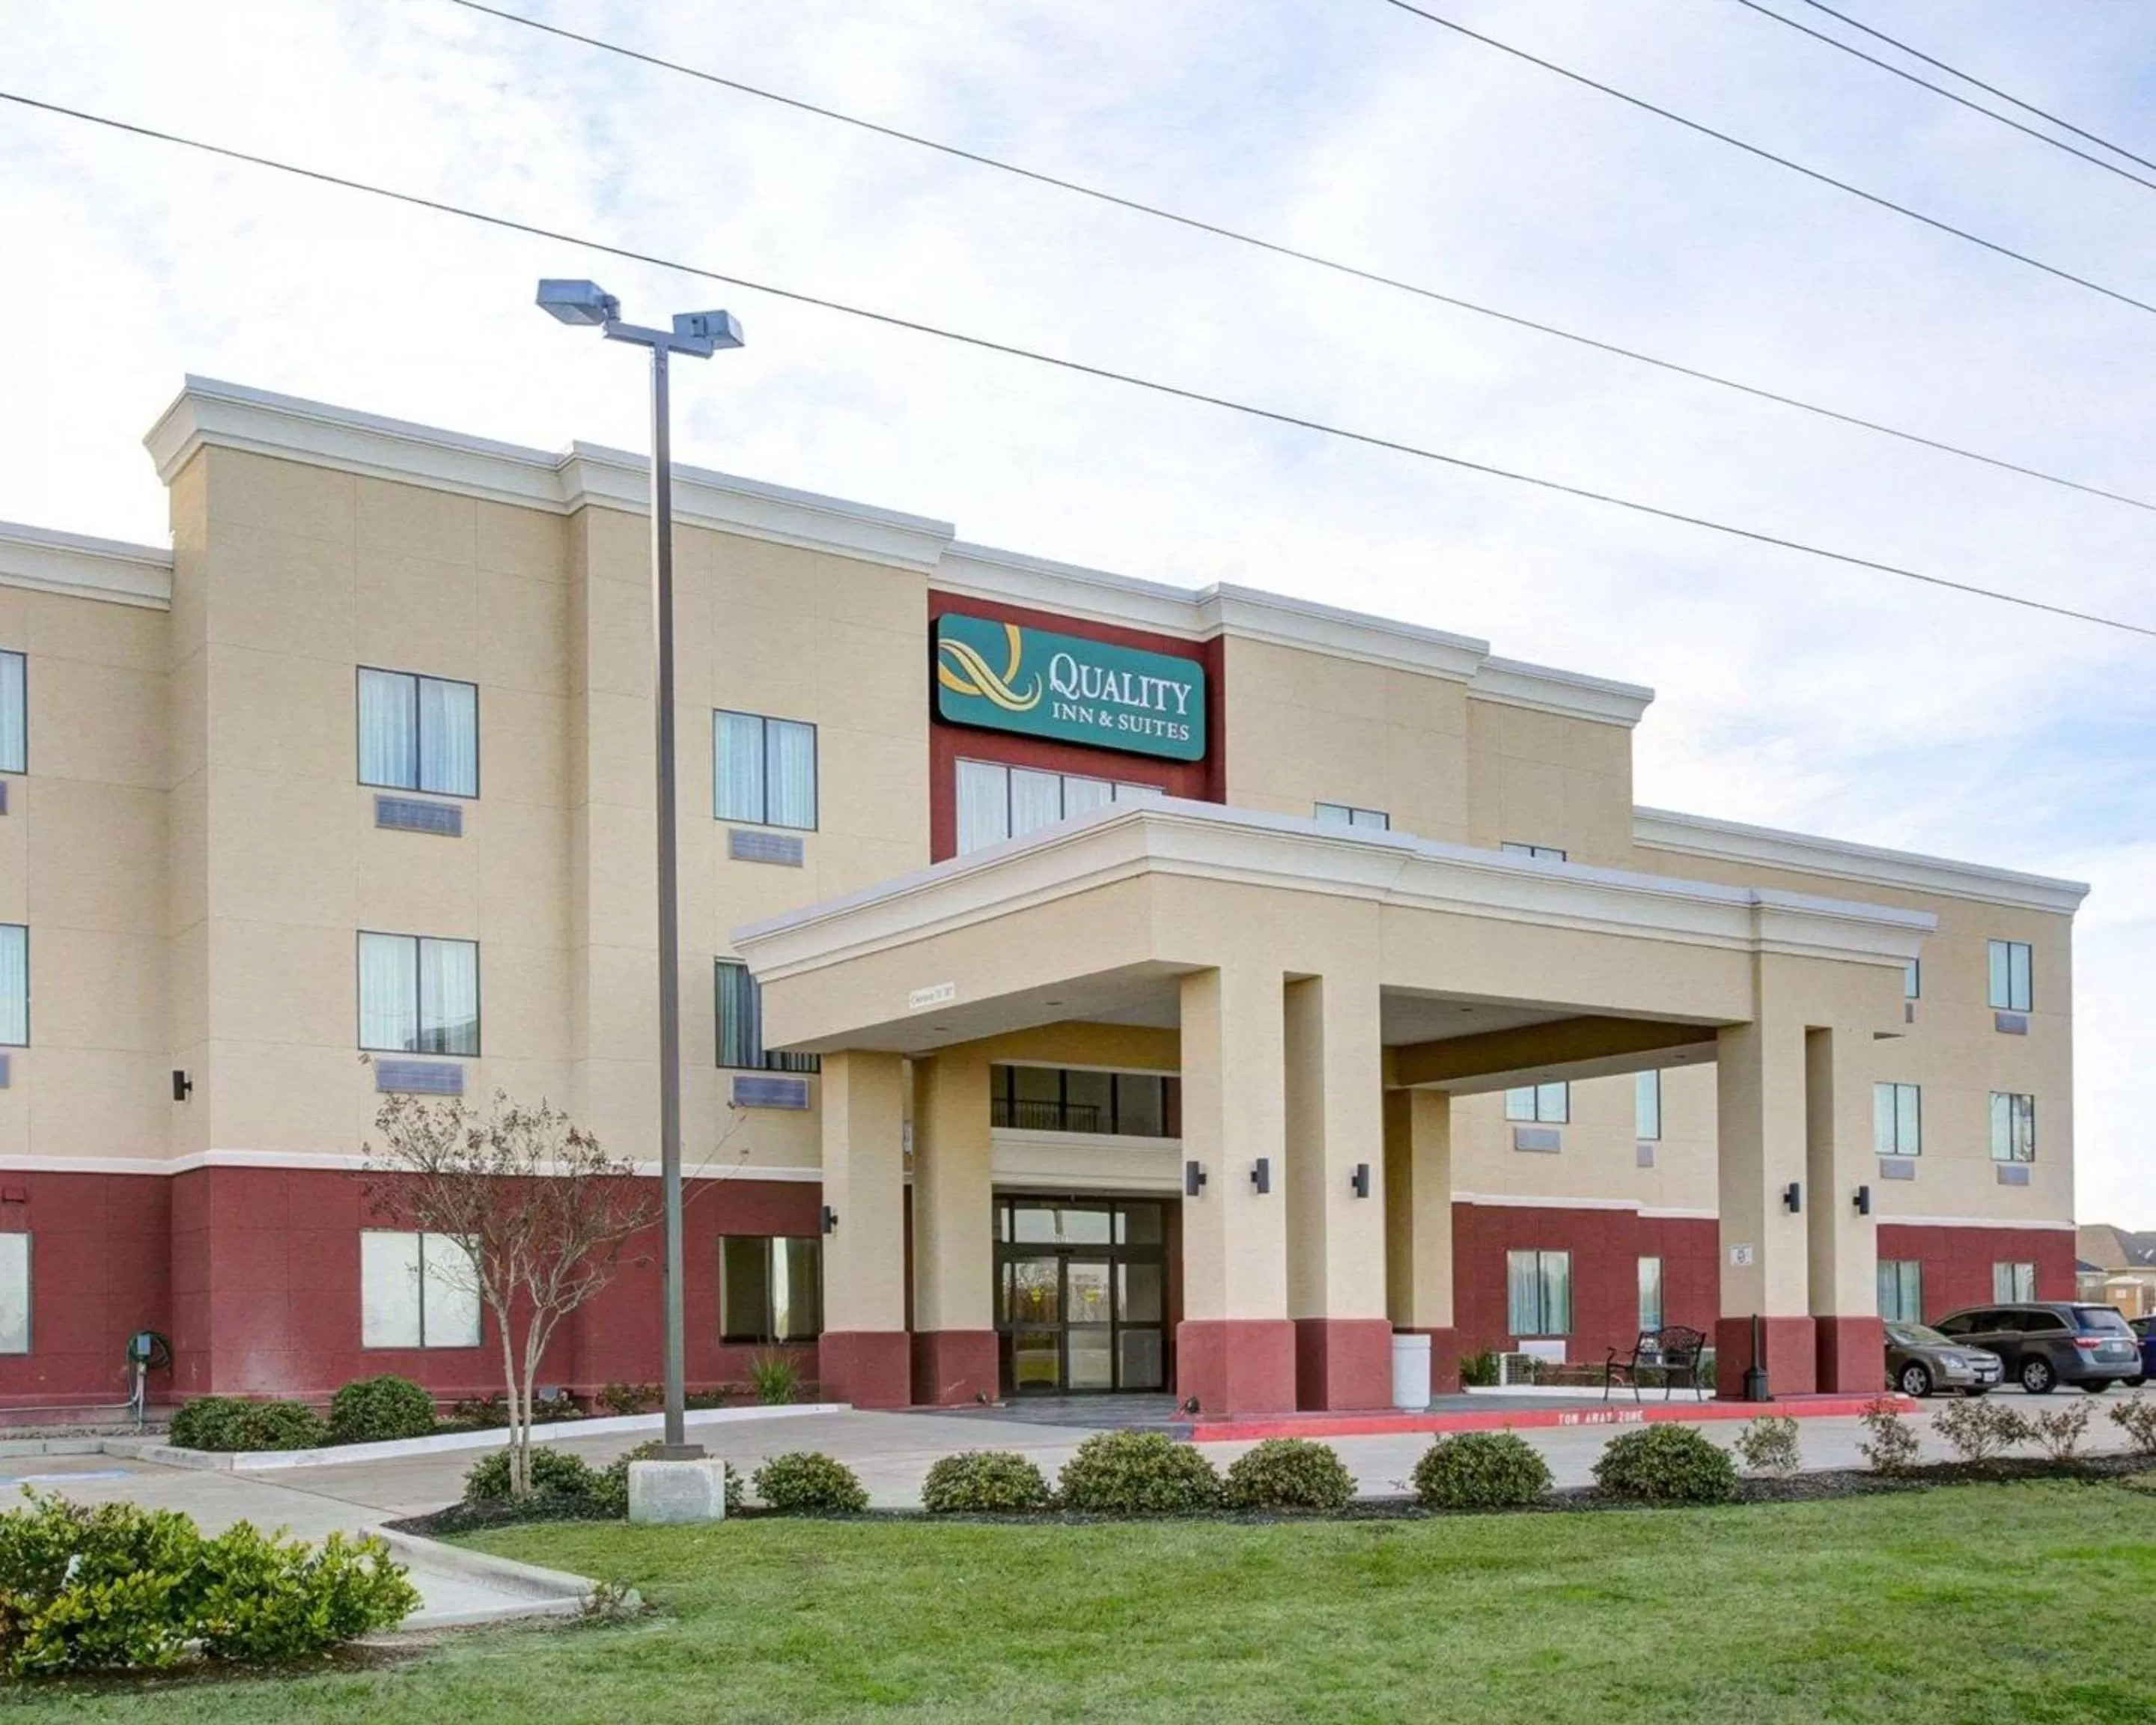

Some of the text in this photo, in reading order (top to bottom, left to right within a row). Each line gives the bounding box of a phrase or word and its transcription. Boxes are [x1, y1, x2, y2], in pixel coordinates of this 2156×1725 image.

[1050, 653, 1192, 715] QUALITY
[1053, 702, 1190, 741] INN & SUITES
